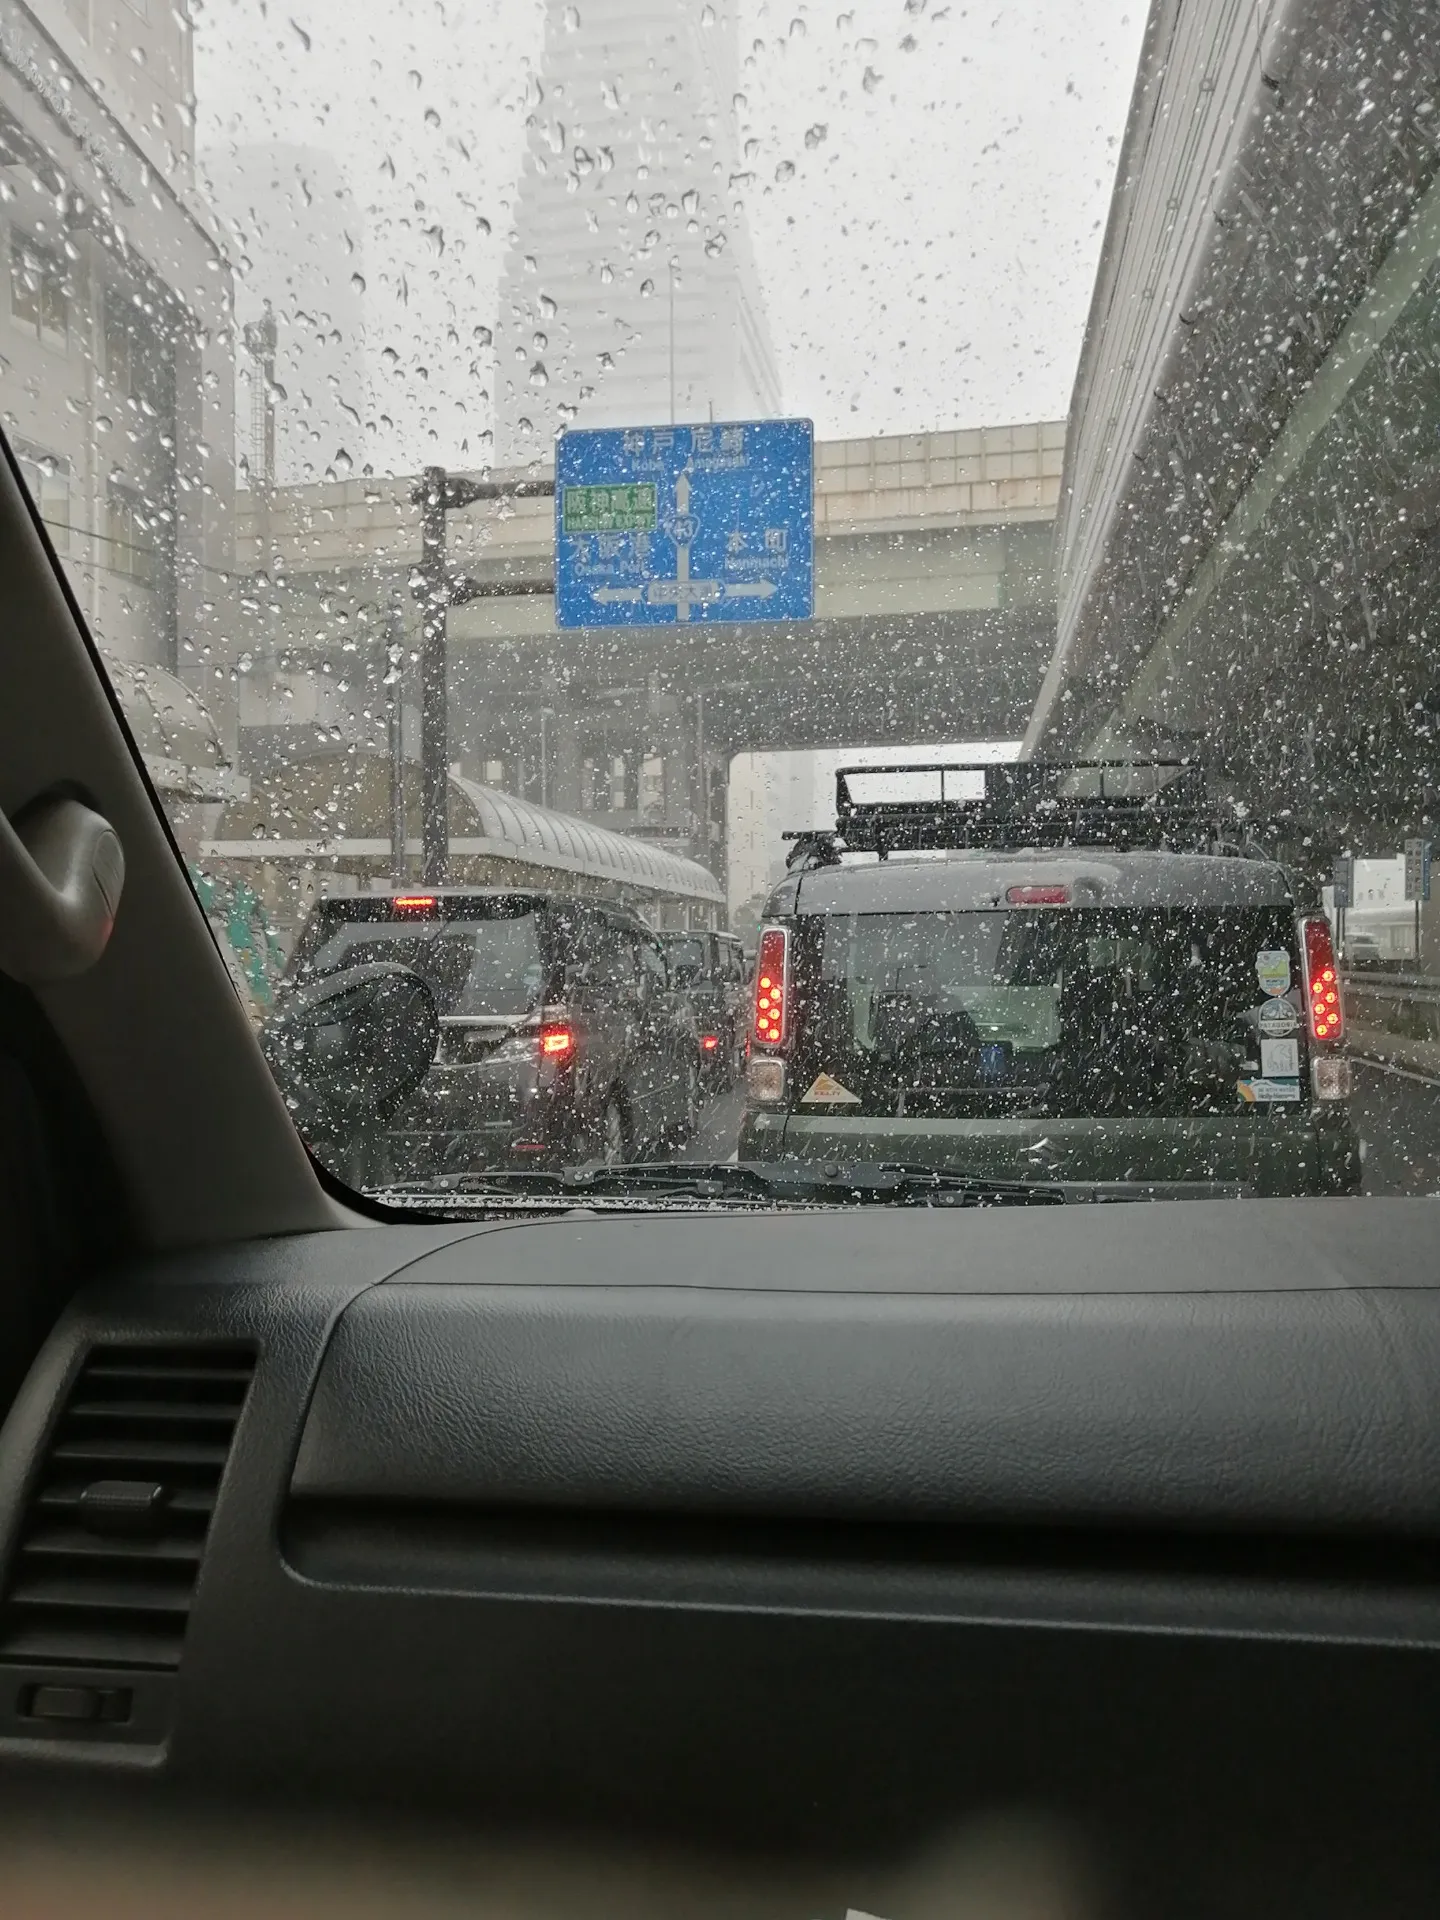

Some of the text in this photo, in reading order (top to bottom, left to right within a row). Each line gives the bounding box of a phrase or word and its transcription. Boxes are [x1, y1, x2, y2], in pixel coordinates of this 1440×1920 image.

[623, 431, 675, 457] 神戸
[632, 459, 665, 472] Kobe
[566, 487, 653, 514] 阪神高速
[673, 520, 693, 537] 43
[567, 534, 651, 562] 大阪港
